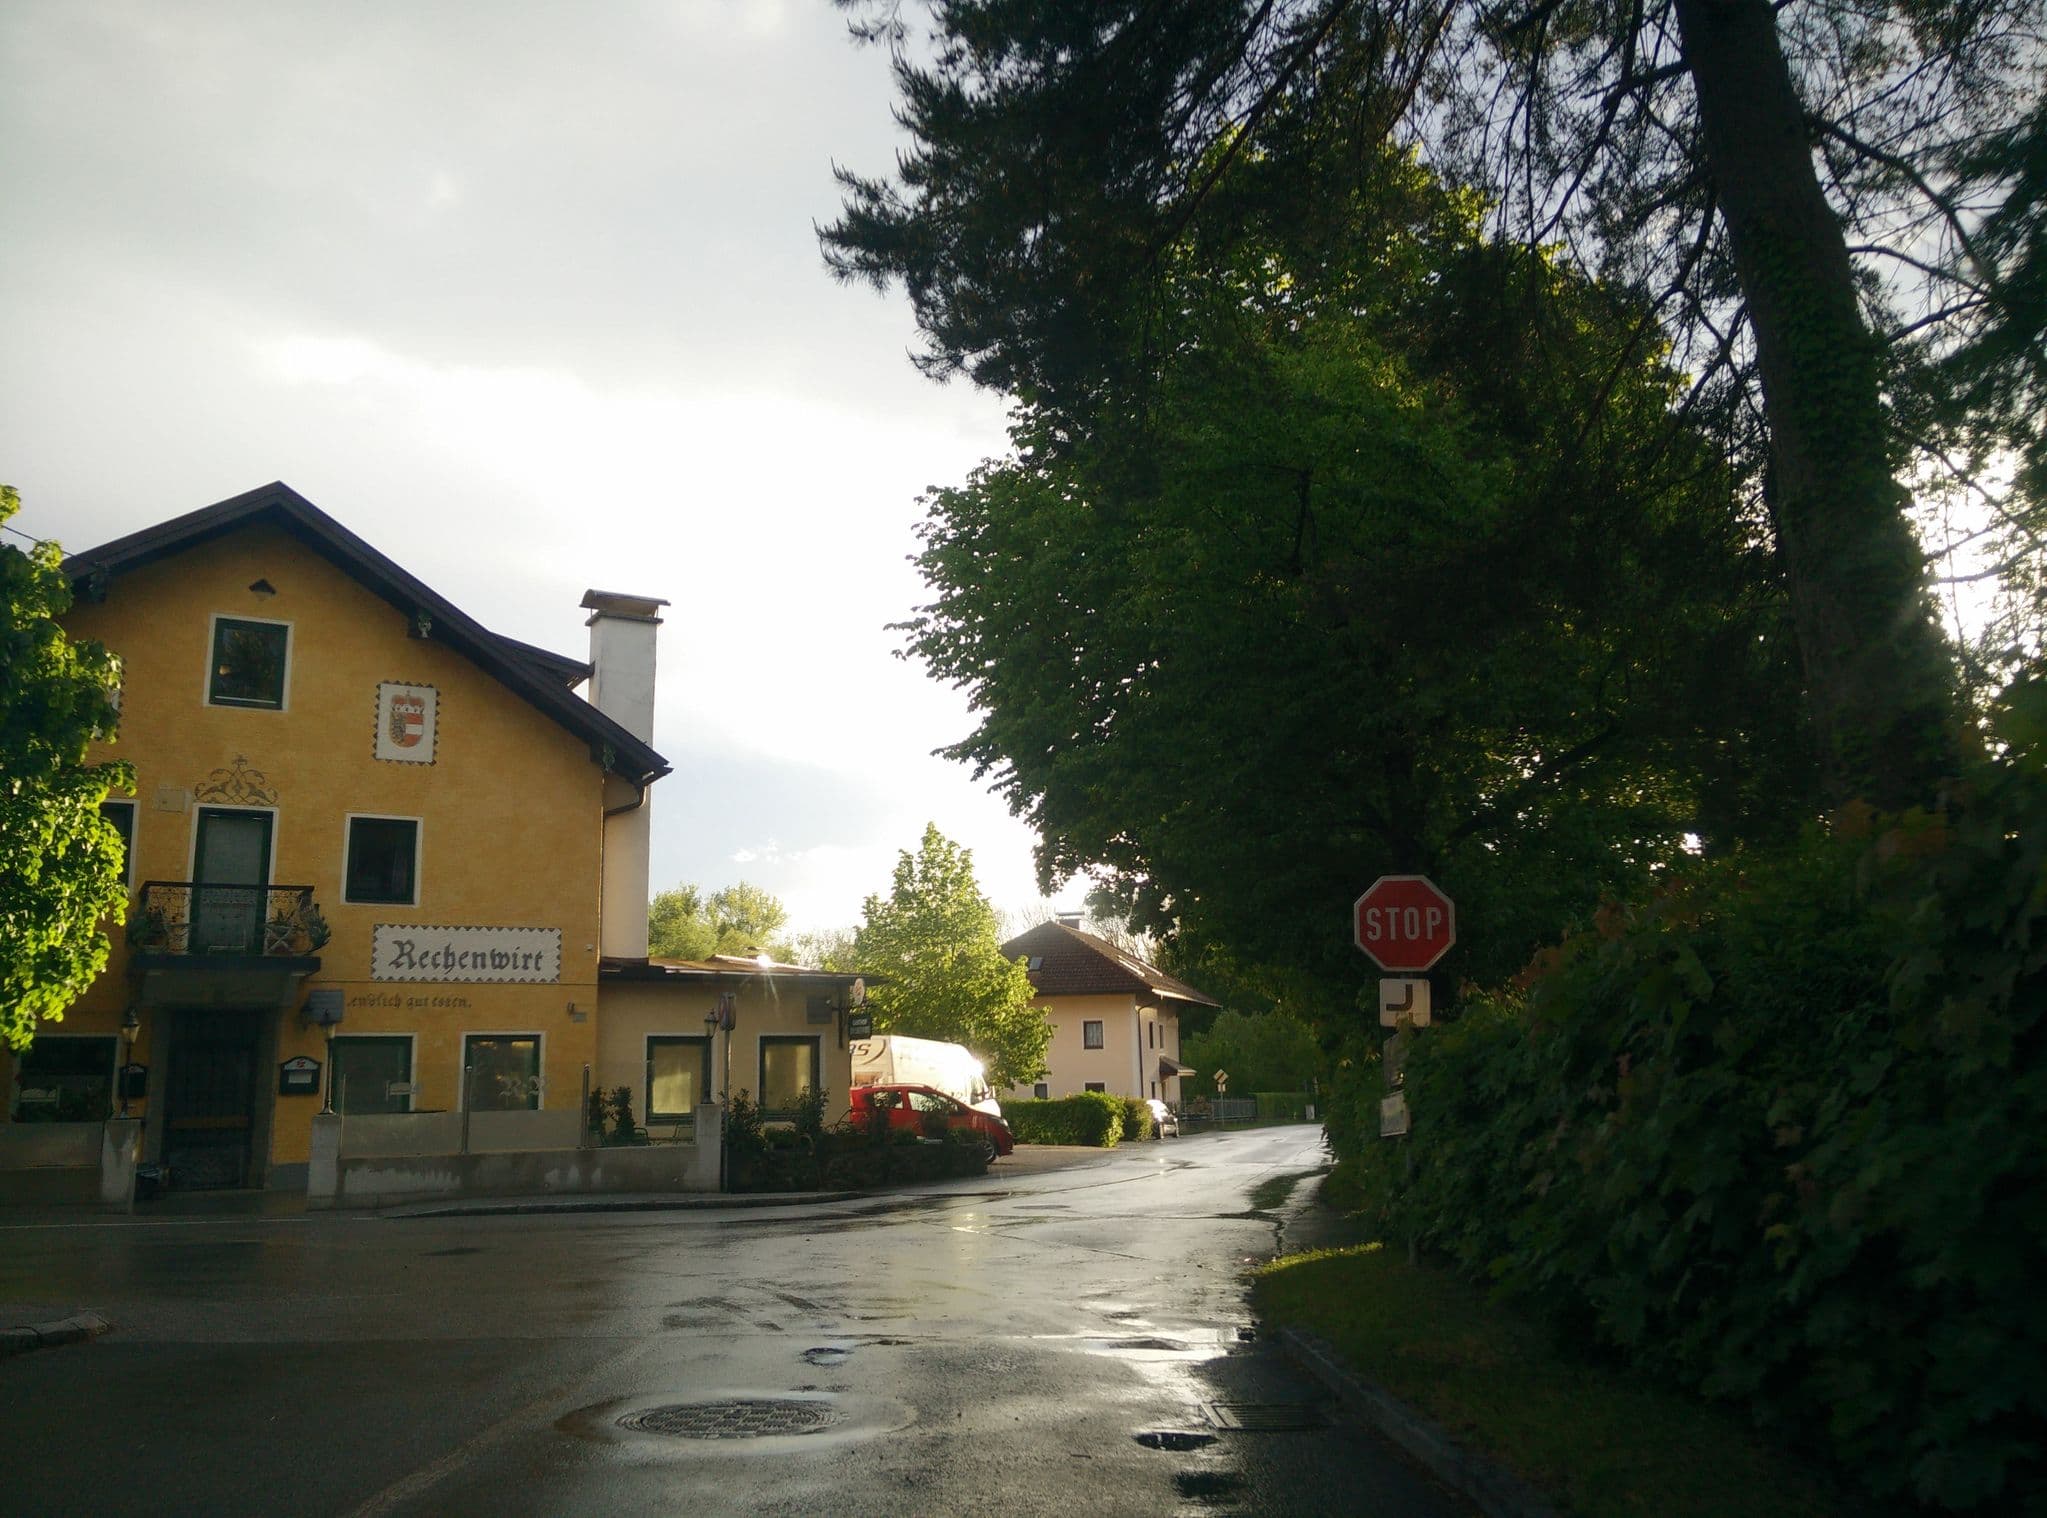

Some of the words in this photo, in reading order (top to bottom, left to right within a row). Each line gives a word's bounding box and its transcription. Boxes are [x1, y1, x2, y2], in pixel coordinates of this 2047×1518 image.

[1366, 906, 1441, 941] STOP
[388, 939, 544, 974] Rechenwirt
[406, 996, 429, 1009] gut
